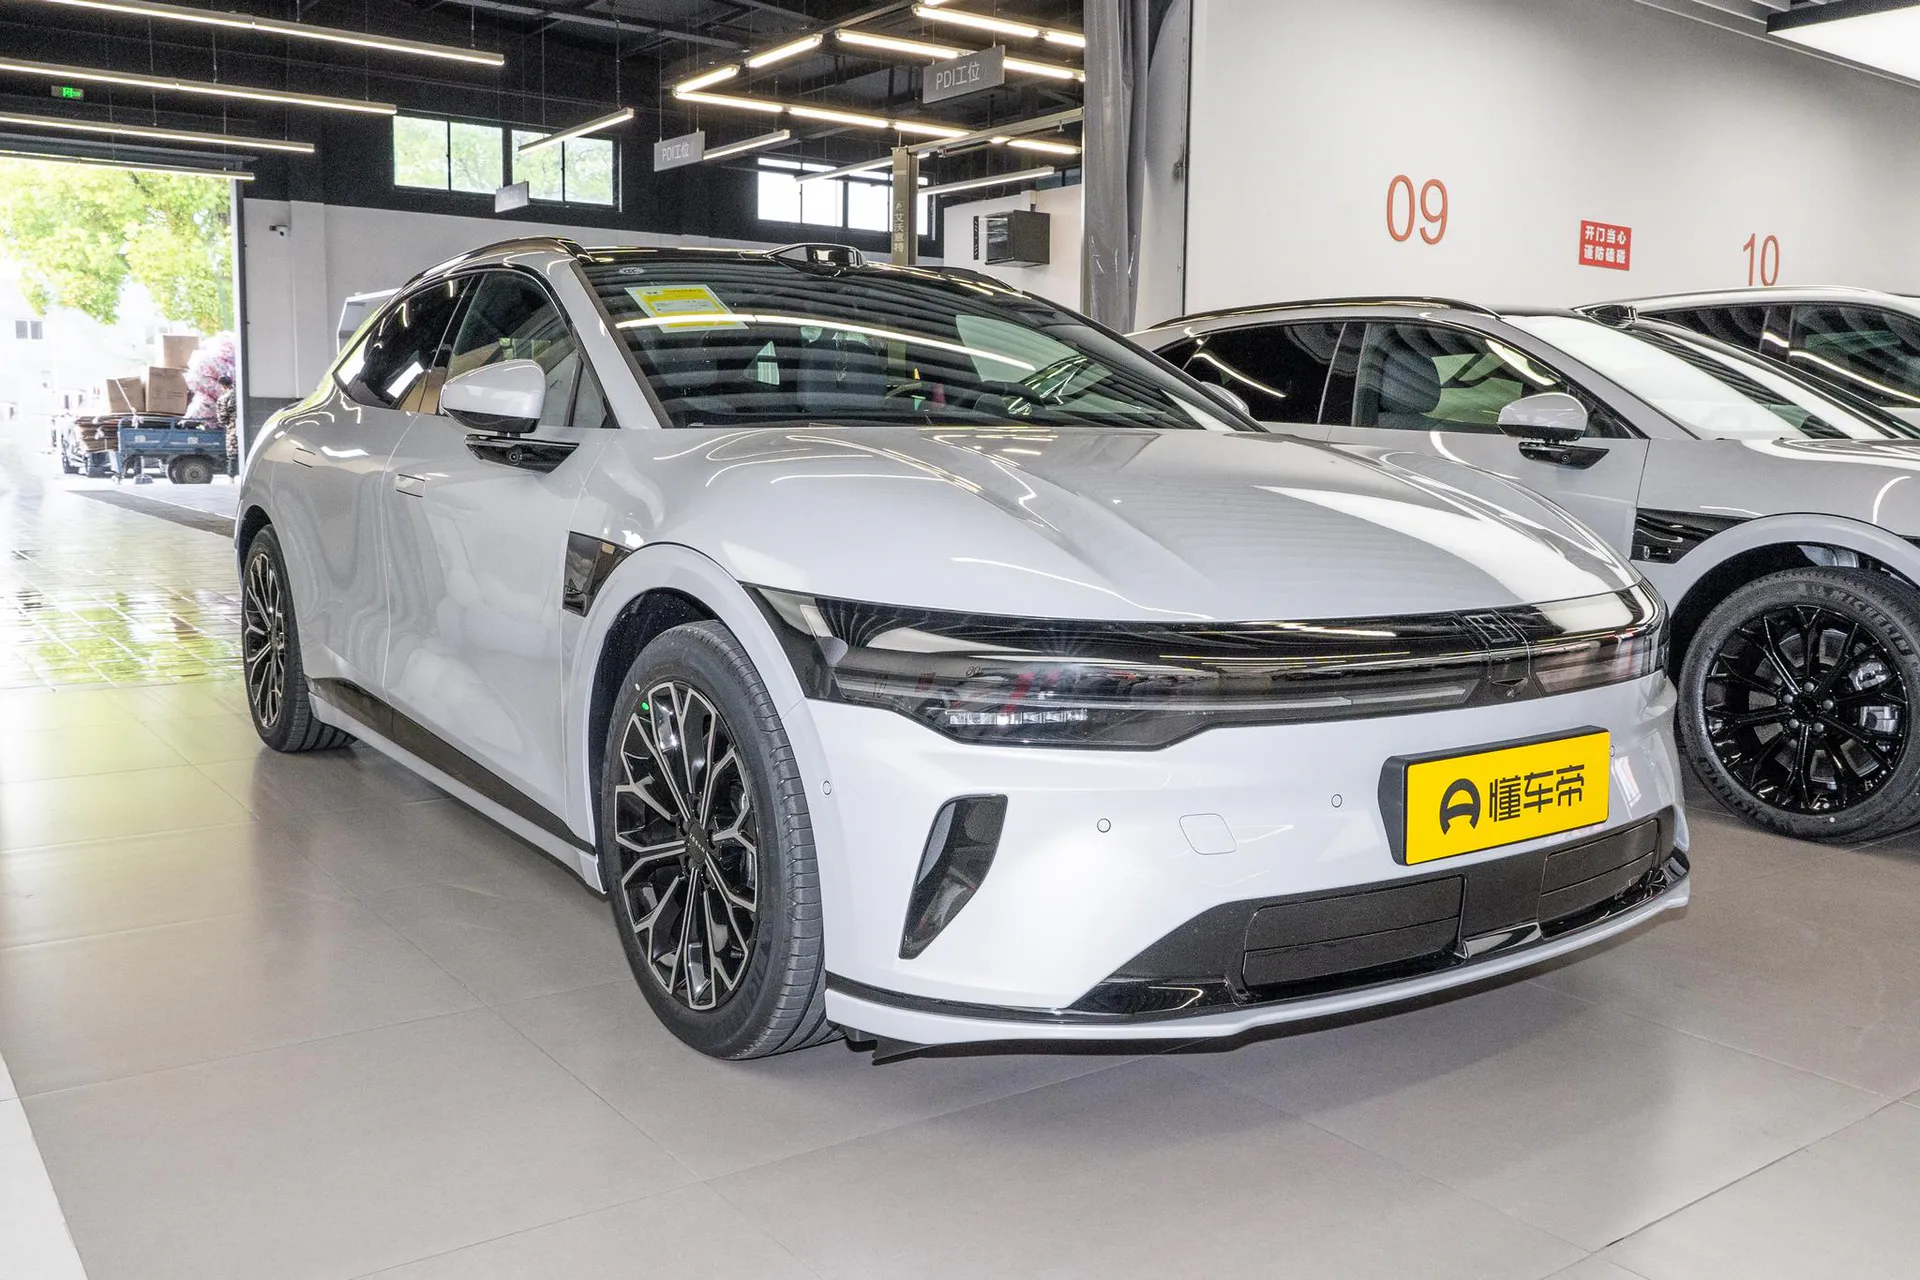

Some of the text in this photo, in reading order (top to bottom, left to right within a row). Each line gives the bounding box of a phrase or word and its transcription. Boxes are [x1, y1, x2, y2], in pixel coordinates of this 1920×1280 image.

[936, 61, 980, 90] PDI工位
[1386, 174, 1448, 245] 09
[1584, 225, 1626, 245] 开门当心
[1742, 232, 1780, 287] 10
[1829, 589, 1912, 653] MICHELIN
[1488, 764, 1585, 823] 懂车帝
